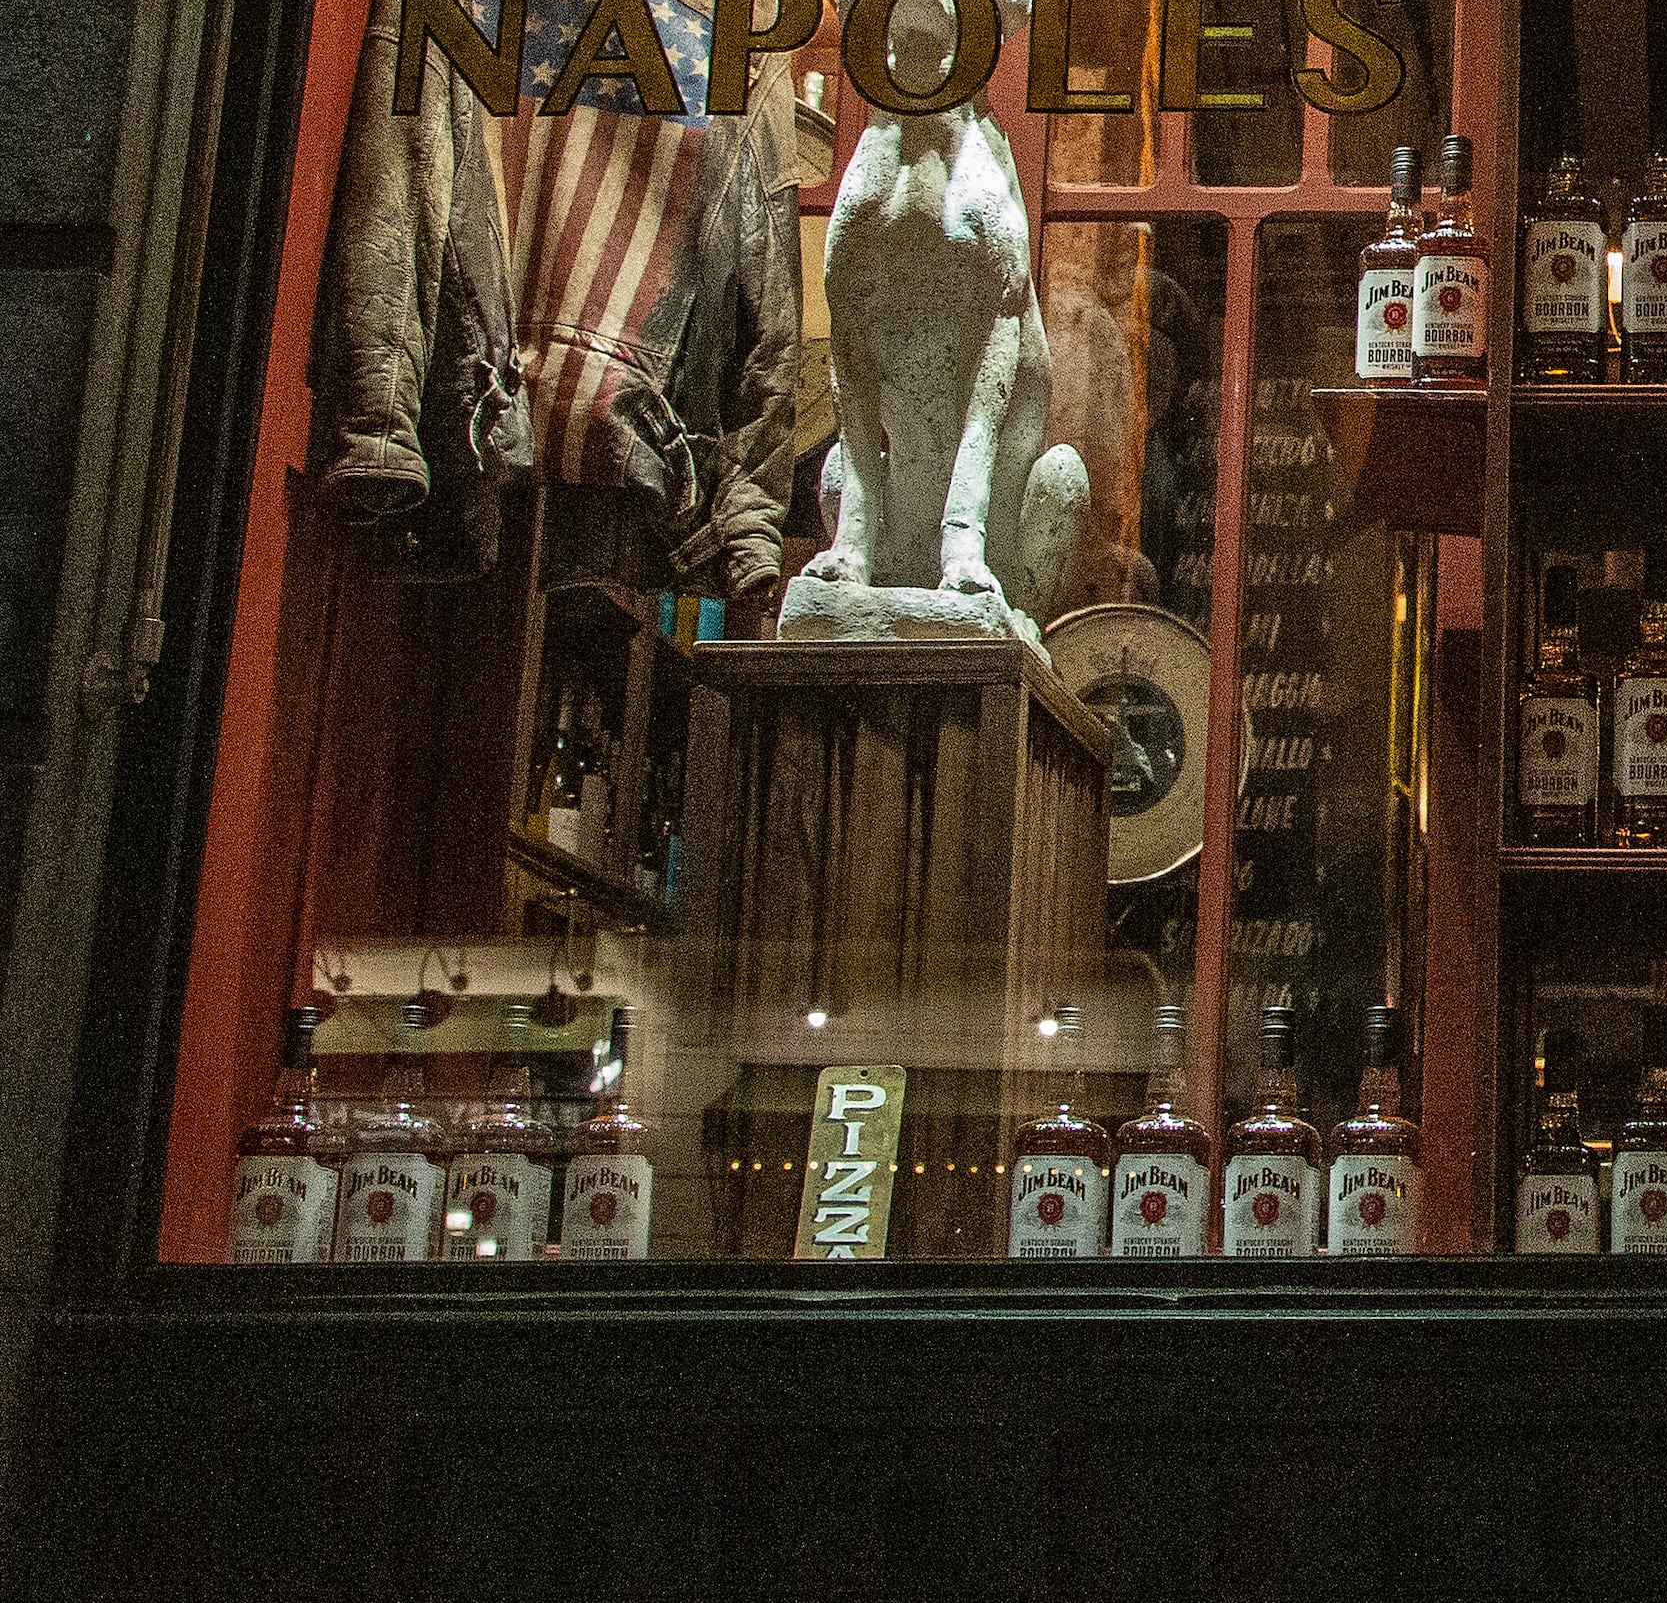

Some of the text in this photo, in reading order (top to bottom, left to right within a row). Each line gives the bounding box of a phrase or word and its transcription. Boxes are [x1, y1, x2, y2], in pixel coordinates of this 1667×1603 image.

[1531, 231, 1596, 262] JIM BEAM
[1630, 237, 1657, 263] JIM
[1421, 265, 1480, 294] JIM BEAM
[1366, 284, 1389, 310] JIM
[1424, 329, 1474, 343] BOURBON
[1368, 349, 1412, 363] BOURBO
[1625, 698, 1651, 721] JIM
[347, 1165, 418, 1199] JIM BEAM
[570, 1166, 640, 1201] JIM BEAM
[811, 1083, 887, 1259] PIZZ
[1120, 1165, 1188, 1199] JIM BEAM
[1619, 1171, 1649, 1199] JIM
[1018, 1173, 1047, 1201] JIM
[1233, 1173, 1261, 1201] JIM
[1338, 1173, 1367, 1201] JIM
[1526, 1186, 1589, 1216] JIM BEAM
